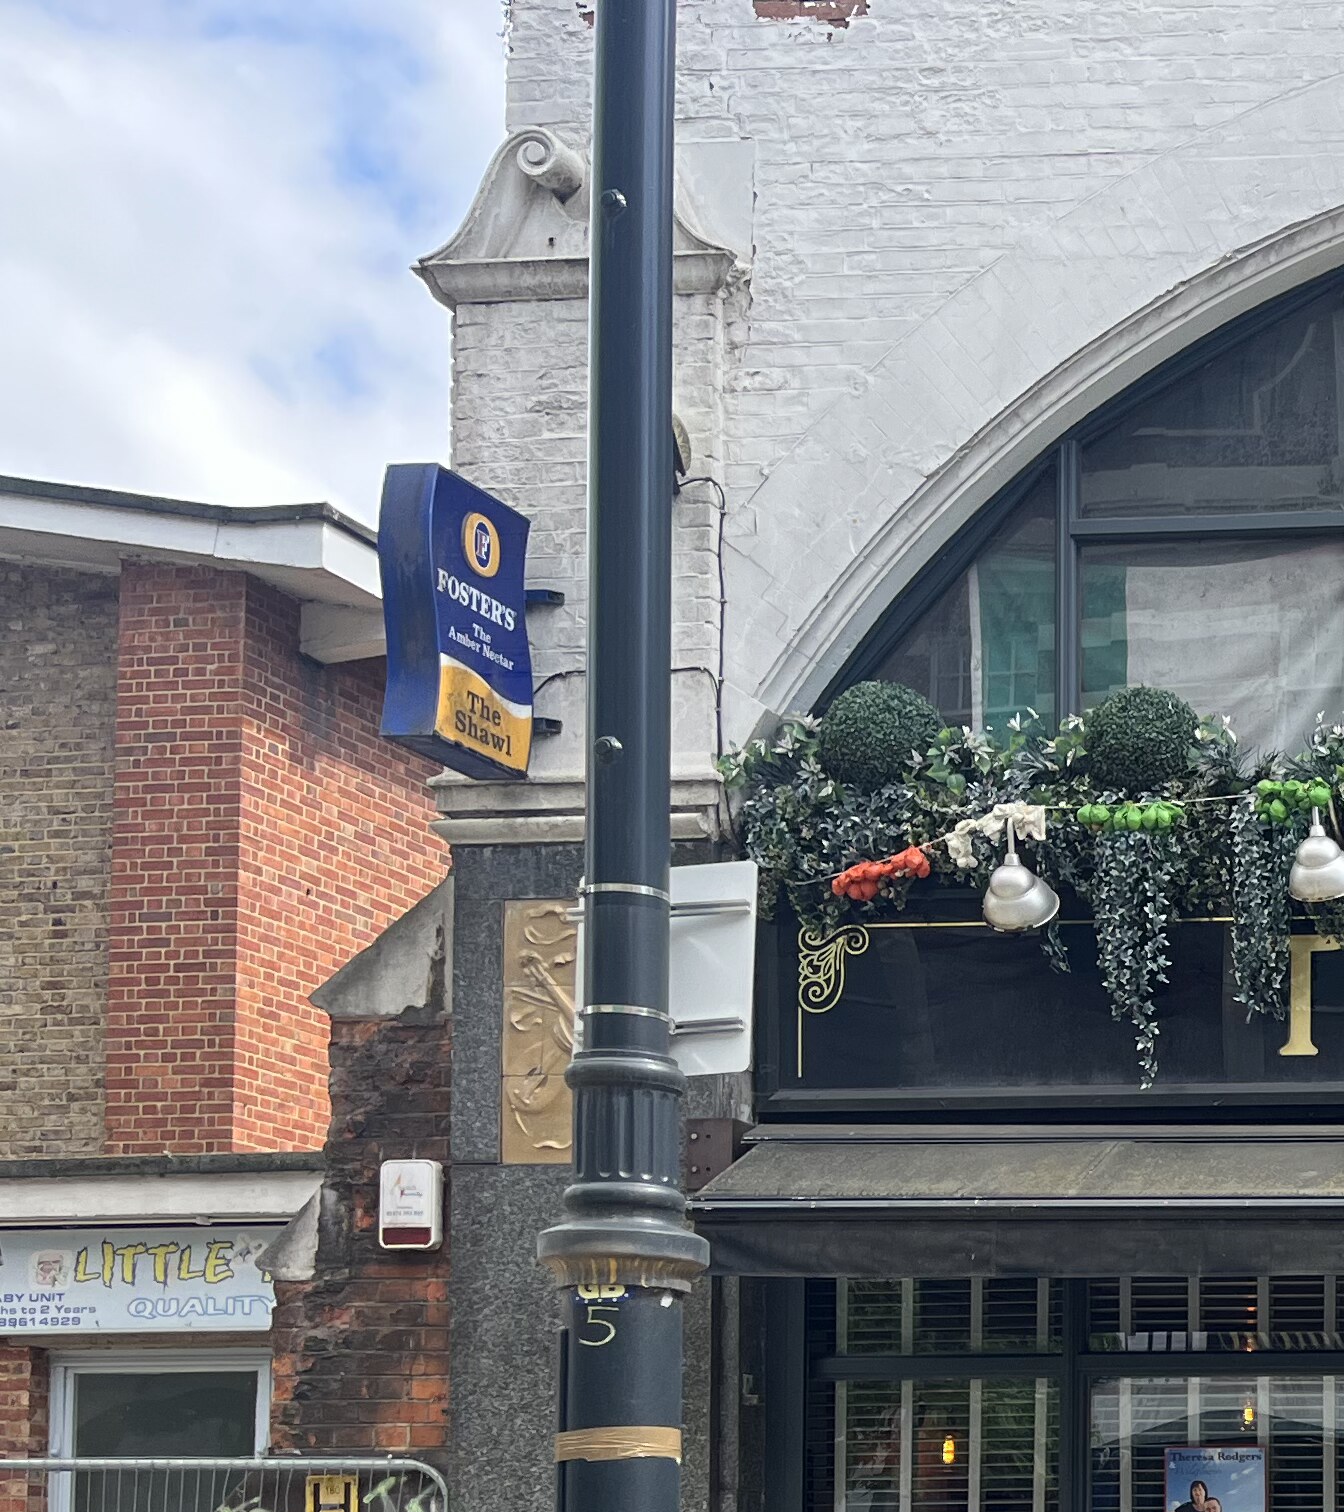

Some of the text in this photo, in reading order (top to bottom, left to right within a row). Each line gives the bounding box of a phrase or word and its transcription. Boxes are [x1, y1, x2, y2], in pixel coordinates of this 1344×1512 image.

[437, 567, 516, 631] FOSTER'S
[448, 626, 515, 671] Amber Nectar
[472, 623, 492, 643] The
[467, 690, 502, 726] The
[455, 710, 512, 757] Shawl
[75, 1237, 235, 1292] LITTLE
[0, 1292, 65, 1303] BY UNIT
[21, 1306, 36, 1315] to
[40, 1305, 50, 1314] 2
[55, 1304, 97, 1314] Years
[127, 1295, 276, 1319] QUALITY
[578, 1306, 620, 1347] 5
[1170, 1451, 1262, 1463] Theresa Rodgers
